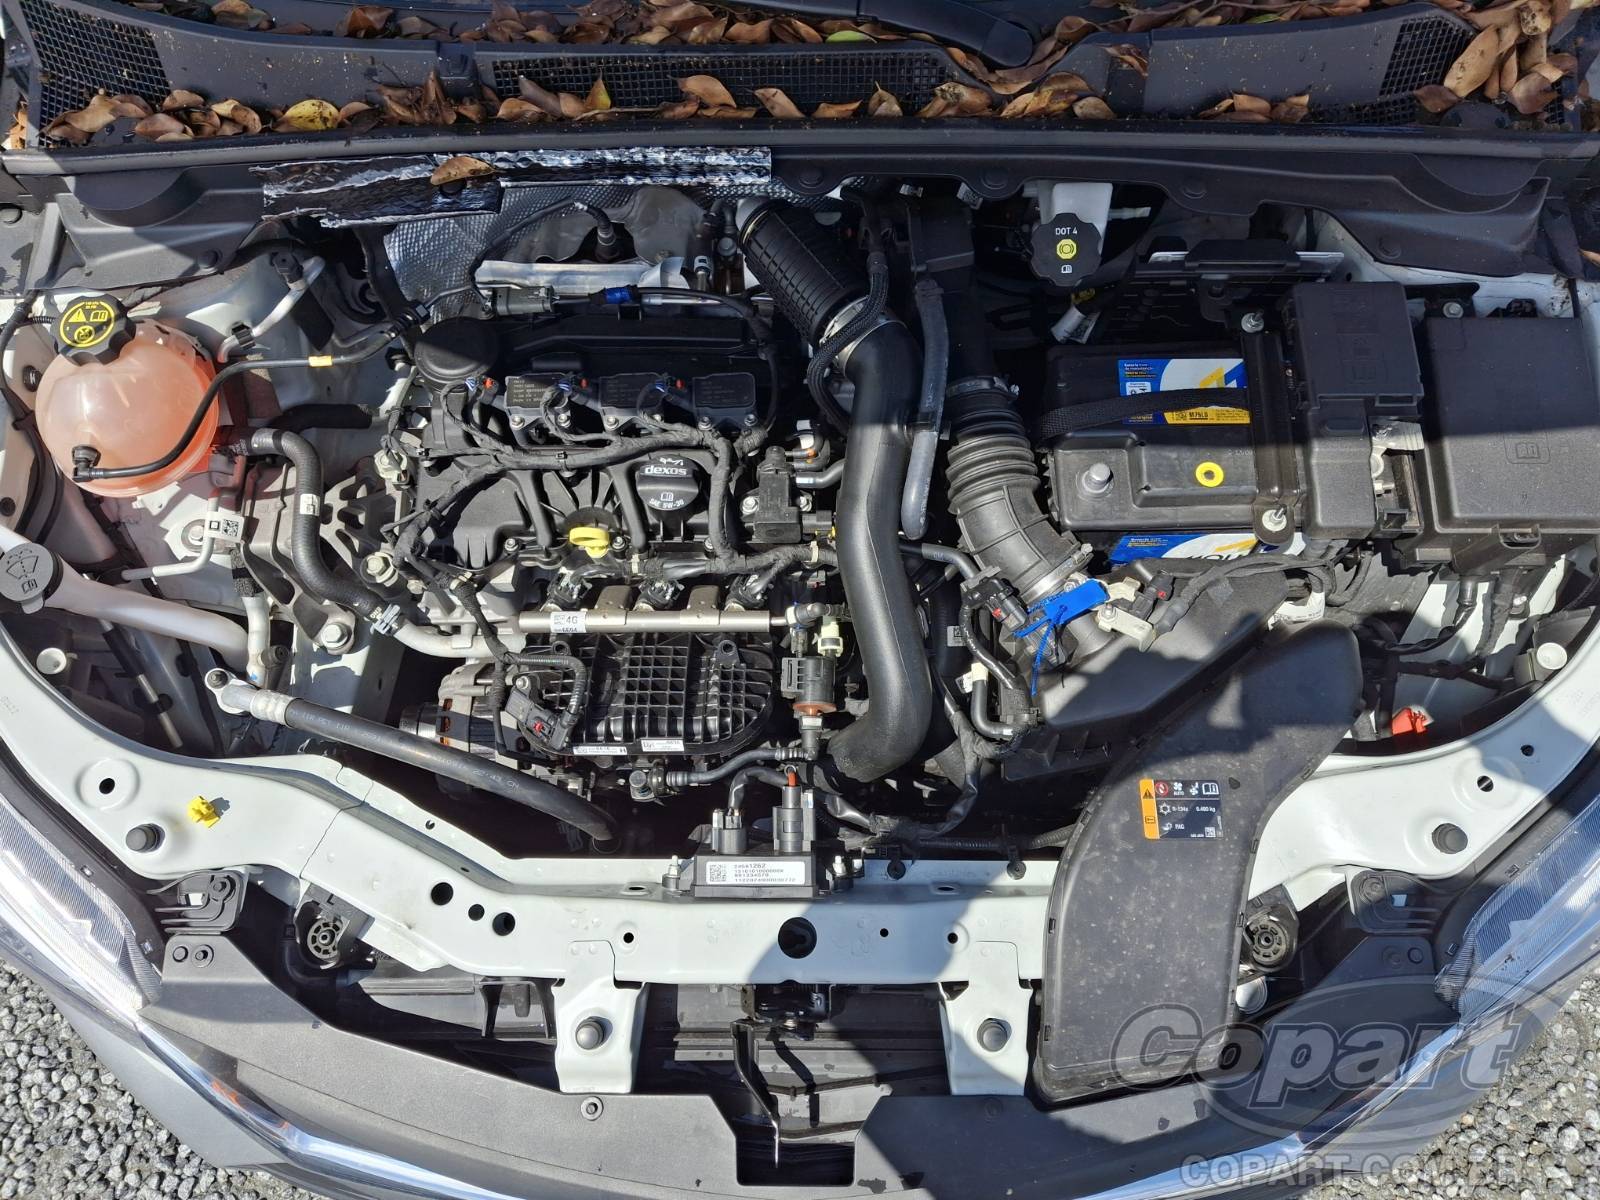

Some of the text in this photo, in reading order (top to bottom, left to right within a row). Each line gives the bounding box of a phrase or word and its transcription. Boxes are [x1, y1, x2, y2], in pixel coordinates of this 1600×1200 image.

[1055, 227, 1078, 235] DOT 4
[645, 465, 687, 476] dexos
[566, 615, 578, 625] 4G
